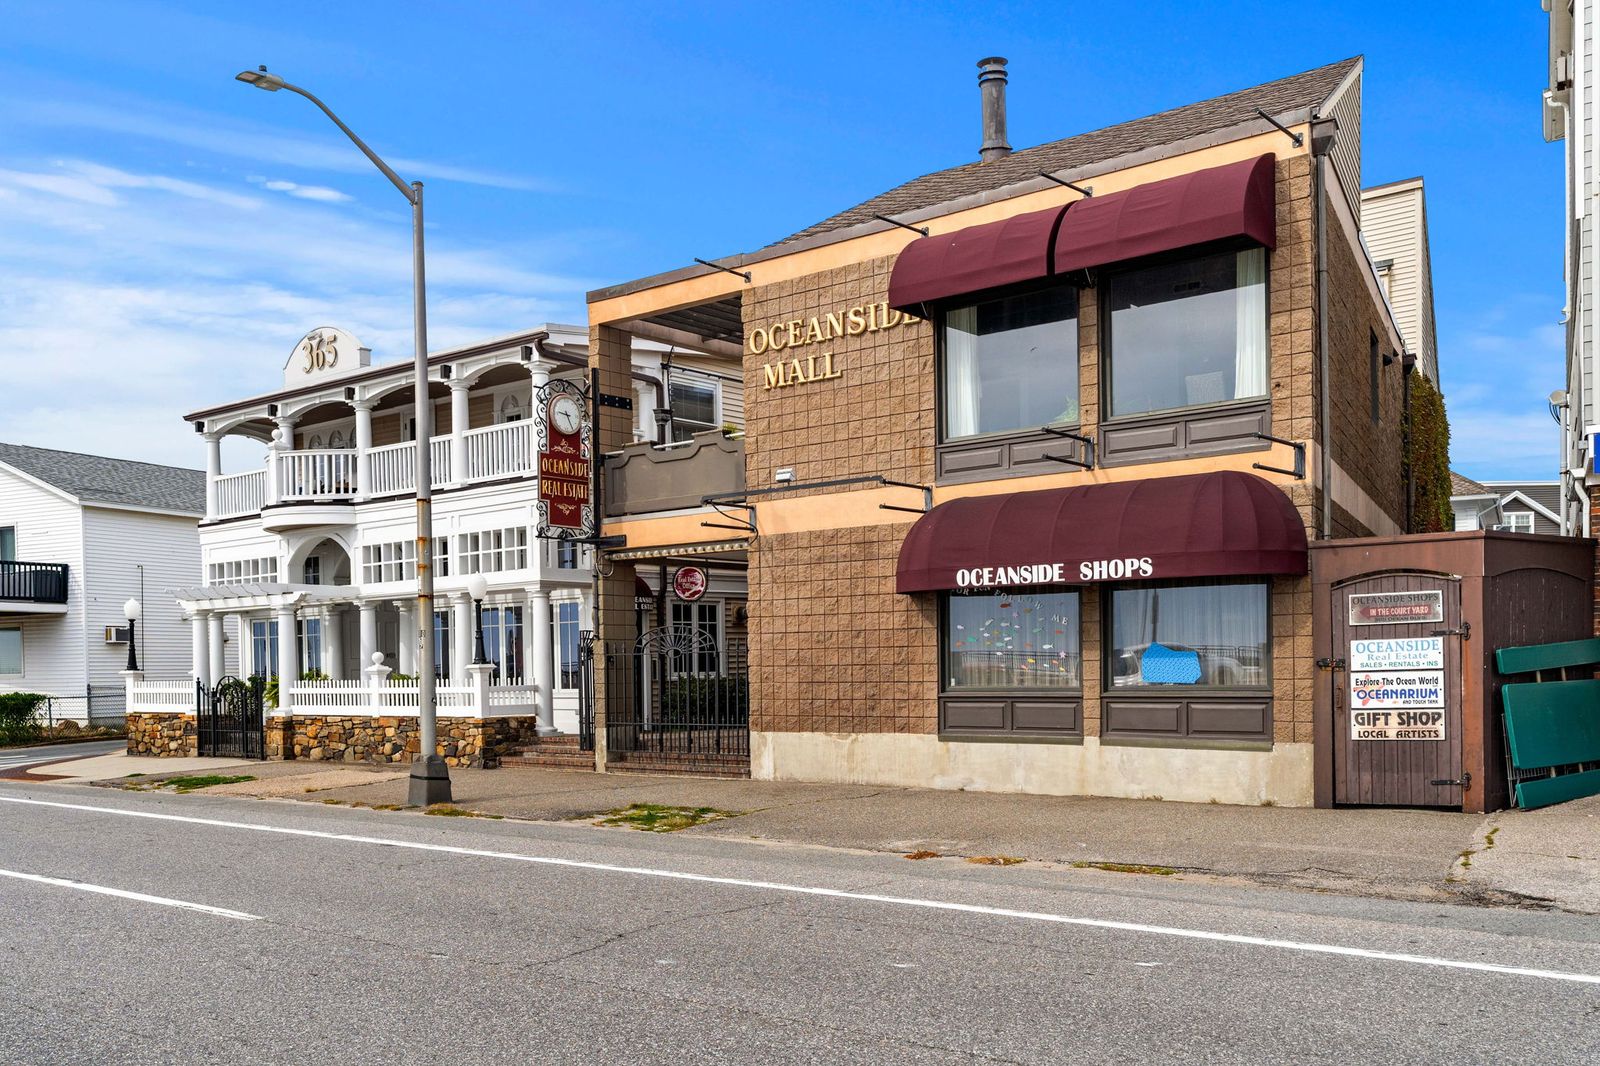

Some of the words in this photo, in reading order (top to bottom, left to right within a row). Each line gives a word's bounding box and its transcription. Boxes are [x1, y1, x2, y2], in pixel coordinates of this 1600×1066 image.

[302, 333, 338, 374] 365
[763, 352, 843, 390] MALL
[542, 458, 588, 477] OCEANSIDE
[542, 480, 561, 498] REAL
[563, 482, 588, 500] ESTATE
[956, 563, 1065, 587] OCEANSIDE
[1079, 557, 1153, 581] SHOPS
[1352, 594, 1405, 605] OCEANSIDE
[1407, 592, 1439, 602] SHOPS
[1370, 608, 1376, 616] IN
[1377, 607, 1389, 616] THE
[1391, 606, 1410, 615] COURT
[1412, 606, 1429, 614] YARD
[1356, 639, 1440, 654] OCEANSIDE
[1367, 653, 1391, 661] Real
[1396, 652, 1429, 660] Estate
[1355, 678, 1379, 687] Explore
[1382, 678, 1394, 686] The
[1396, 677, 1416, 685] Ocean
[1418, 676, 1438, 685] World
[1357, 688, 1438, 699] OCEANARIUM
[1355, 713, 1391, 727] GIFT
[1397, 712, 1442, 727] SHOP
[1396, 730, 1439, 738] ARTISTS
